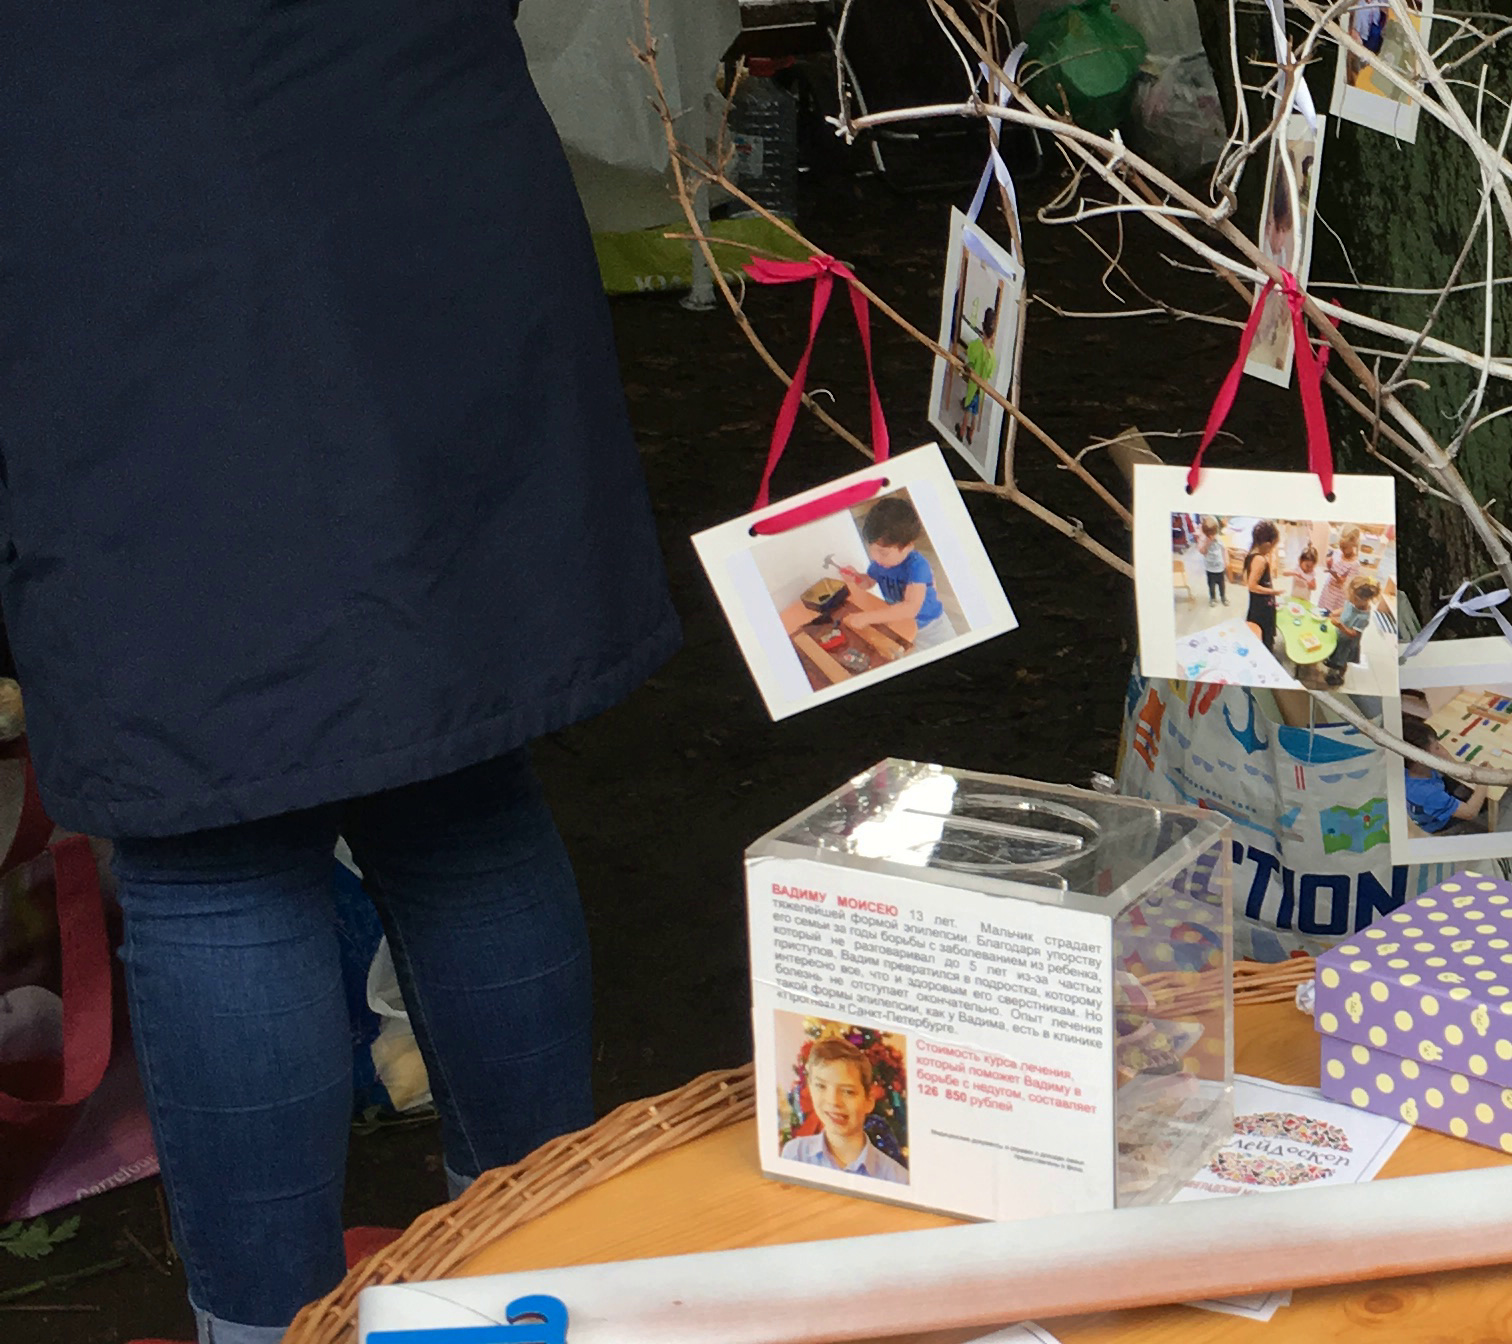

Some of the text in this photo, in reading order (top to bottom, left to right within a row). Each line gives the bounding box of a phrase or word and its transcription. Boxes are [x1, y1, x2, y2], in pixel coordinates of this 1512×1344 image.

[772, 884, 826, 902] ВАДИМУ
[838, 896, 898, 916] МОИСЕЮ
[981, 922, 1033, 941] Мальчик
[1045, 936, 1101, 953] страдает
[773, 913, 791, 923] его
[794, 917, 830, 930] семьи
[850, 927, 877, 939] годы
[881, 931, 925, 948] борьбы
[774, 926, 821, 941] который
[987, 966, 1007, 977] лет
[1017, 973, 1048, 985] из-за
[1058, 980, 1102, 994] частых
[851, 913, 898, 929] формой
[1047, 951, 1102, 970] упорству
[775, 963, 823, 981] болезнь
[1011, 1008, 1043, 1023] Опыт
[1051, 1019, 1102, 1035] лечения
[841, 949, 879, 966] Вадим
[1045, 991, 1102, 1010] которому
[869, 971, 889, 981] что
[908, 978, 967, 996] здоровым
[973, 990, 992, 1001] его
[776, 978, 808, 991] такой
[811, 984, 853, 1000] формы
[926, 1008, 945, 1018] как
[958, 1011, 1008, 1031] Вадима,
[1012, 1024, 1039, 1037] есть
[1053, 1033, 1102, 1049] клинике
[916, 1057, 965, 1073] который
[969, 1067, 1020, 1083] поможет
[1024, 1075, 1070, 1096] Вадиму
[917, 1069, 959, 1086] борьбе
[984, 1053, 1017, 1069] курса
[918, 1084, 1013, 1111] 126 850 рублей
[1224, 1138, 1350, 1167] лейдоскоп
